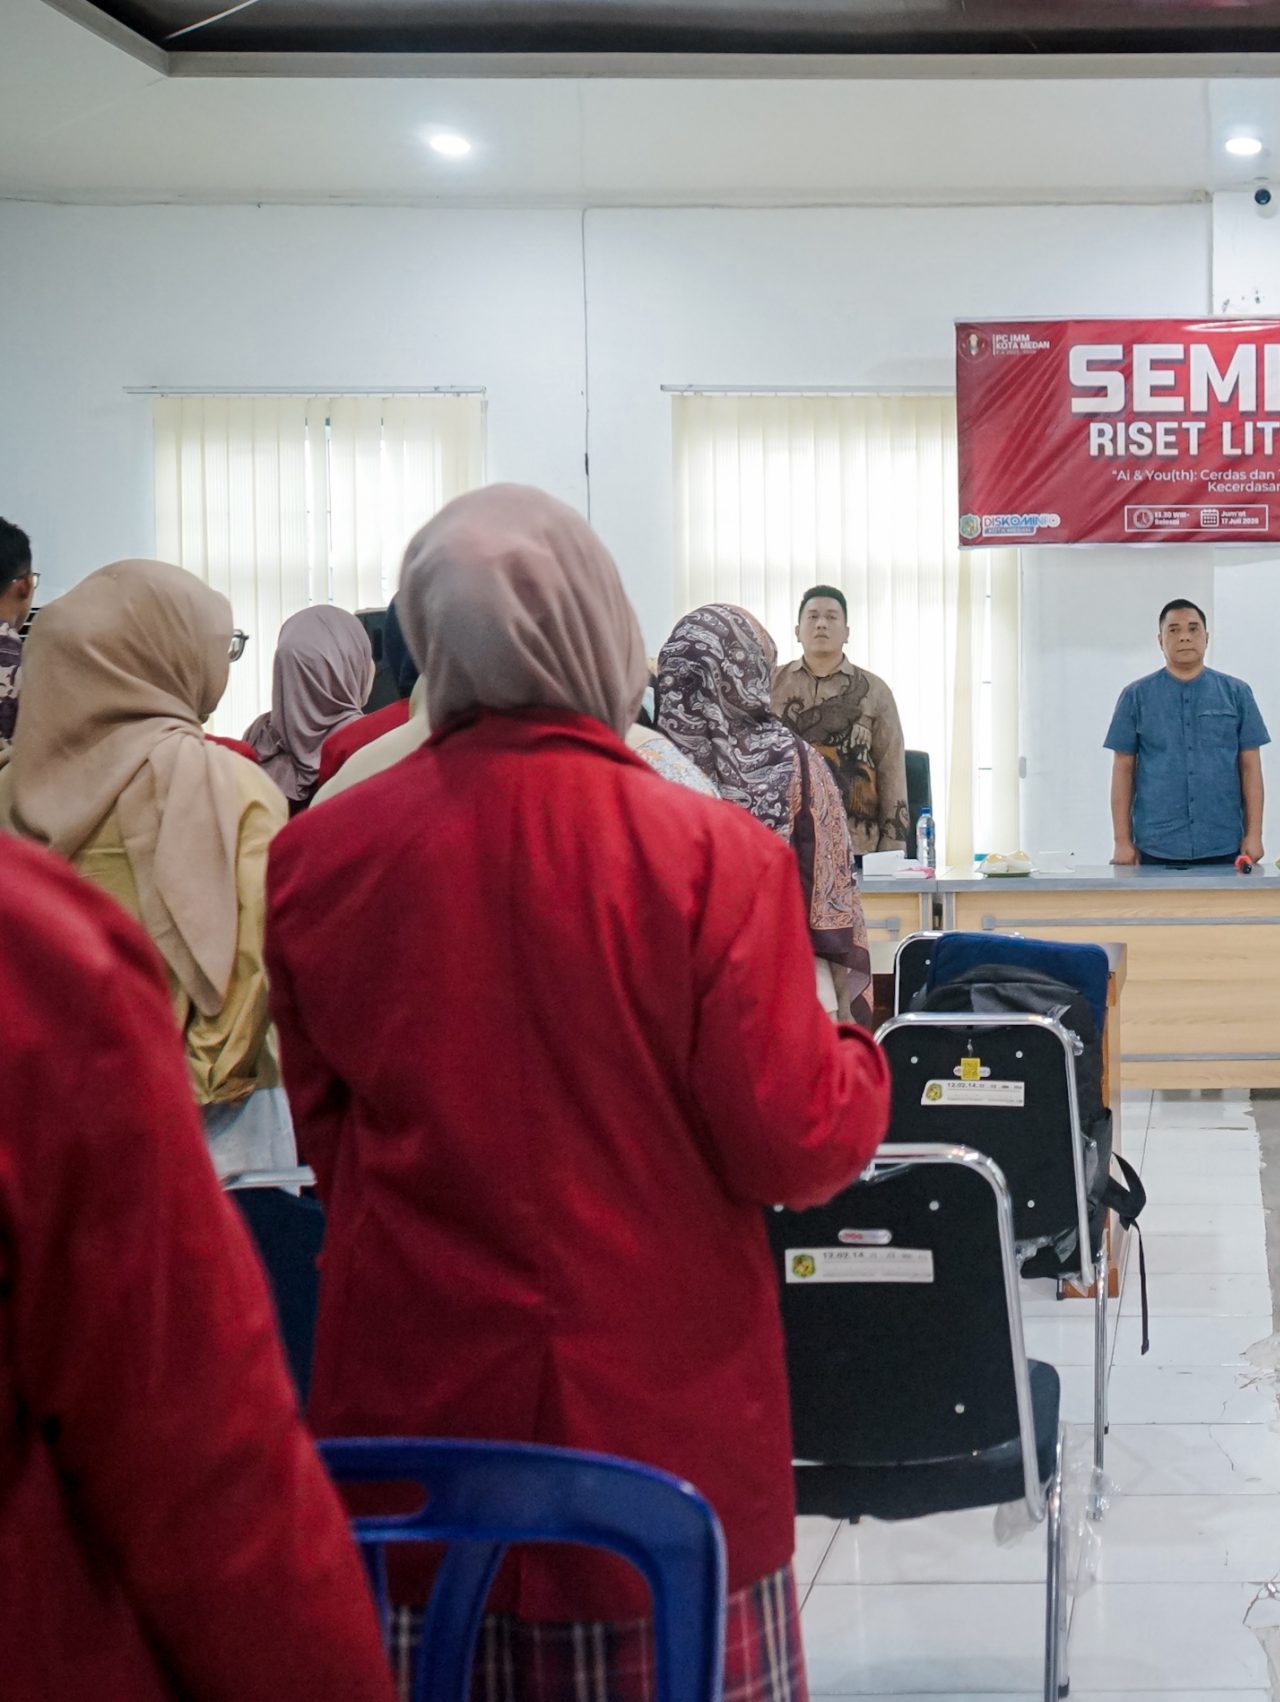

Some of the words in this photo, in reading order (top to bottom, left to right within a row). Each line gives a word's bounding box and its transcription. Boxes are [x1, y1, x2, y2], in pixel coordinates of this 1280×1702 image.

[995, 333, 1008, 342] PC
[1010, 333, 1030, 341] IMM
[995, 341, 1019, 350] KOTA
[1020, 340, 1050, 350] MEDAN
[1089, 421, 1205, 456] RISET
[1133, 470, 1143, 480] &
[1146, 469, 1198, 482] You(th):
[1200, 469, 1246, 480] Cerdas
[1249, 469, 1274, 480] dan
[983, 514, 1060, 527] DISKOMINFO
[1229, 517, 1241, 525] Juli
